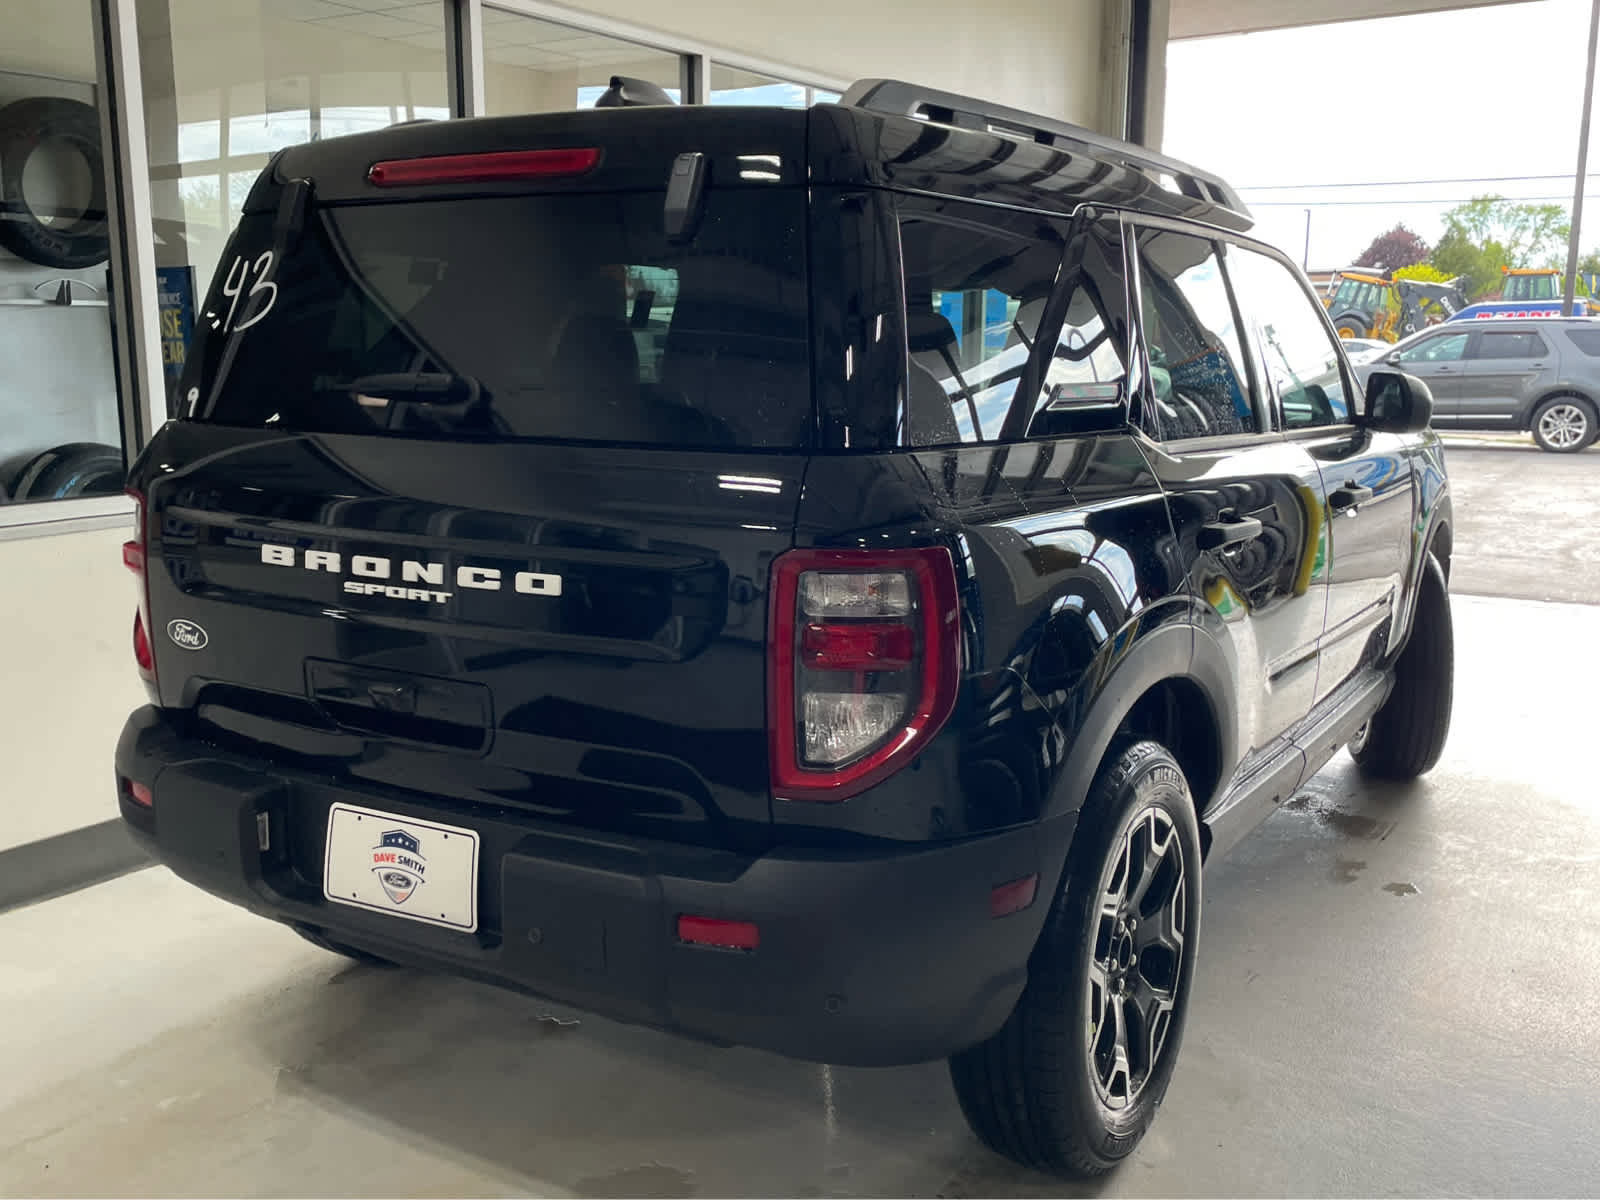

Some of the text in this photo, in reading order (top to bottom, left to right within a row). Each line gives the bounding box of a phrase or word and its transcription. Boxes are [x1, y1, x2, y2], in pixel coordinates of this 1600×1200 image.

[223, 250, 278, 334] 43
[261, 543, 563, 597] BRONCO
[343, 580, 453, 605] SPORT
[174, 623, 200, 646] Ford
[373, 853, 426, 875] DAVE SMITH
